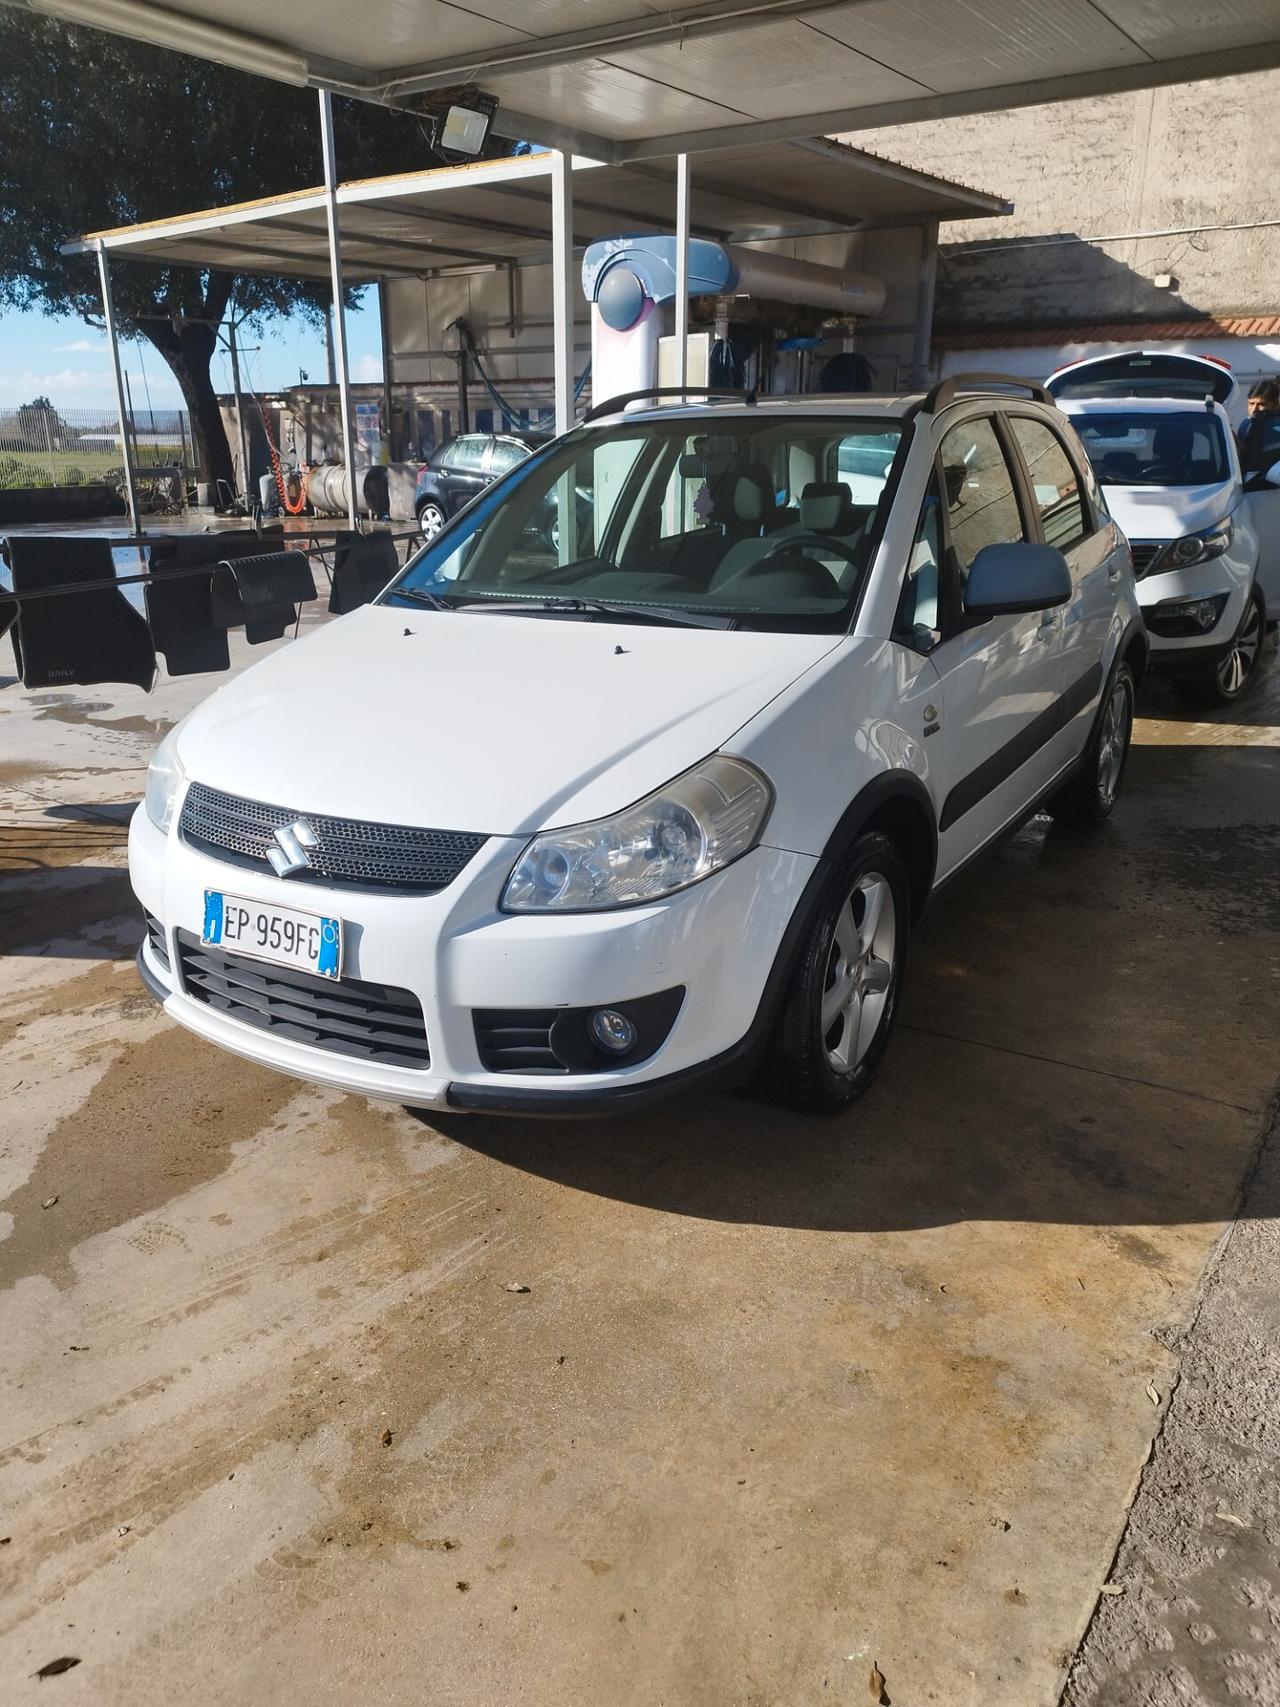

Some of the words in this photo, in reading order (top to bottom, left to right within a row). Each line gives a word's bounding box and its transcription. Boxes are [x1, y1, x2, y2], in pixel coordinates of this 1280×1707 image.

[47, 668, 76, 678] DAILY
[225, 905, 249, 939] EP
[257, 914, 319, 959] 959FG
